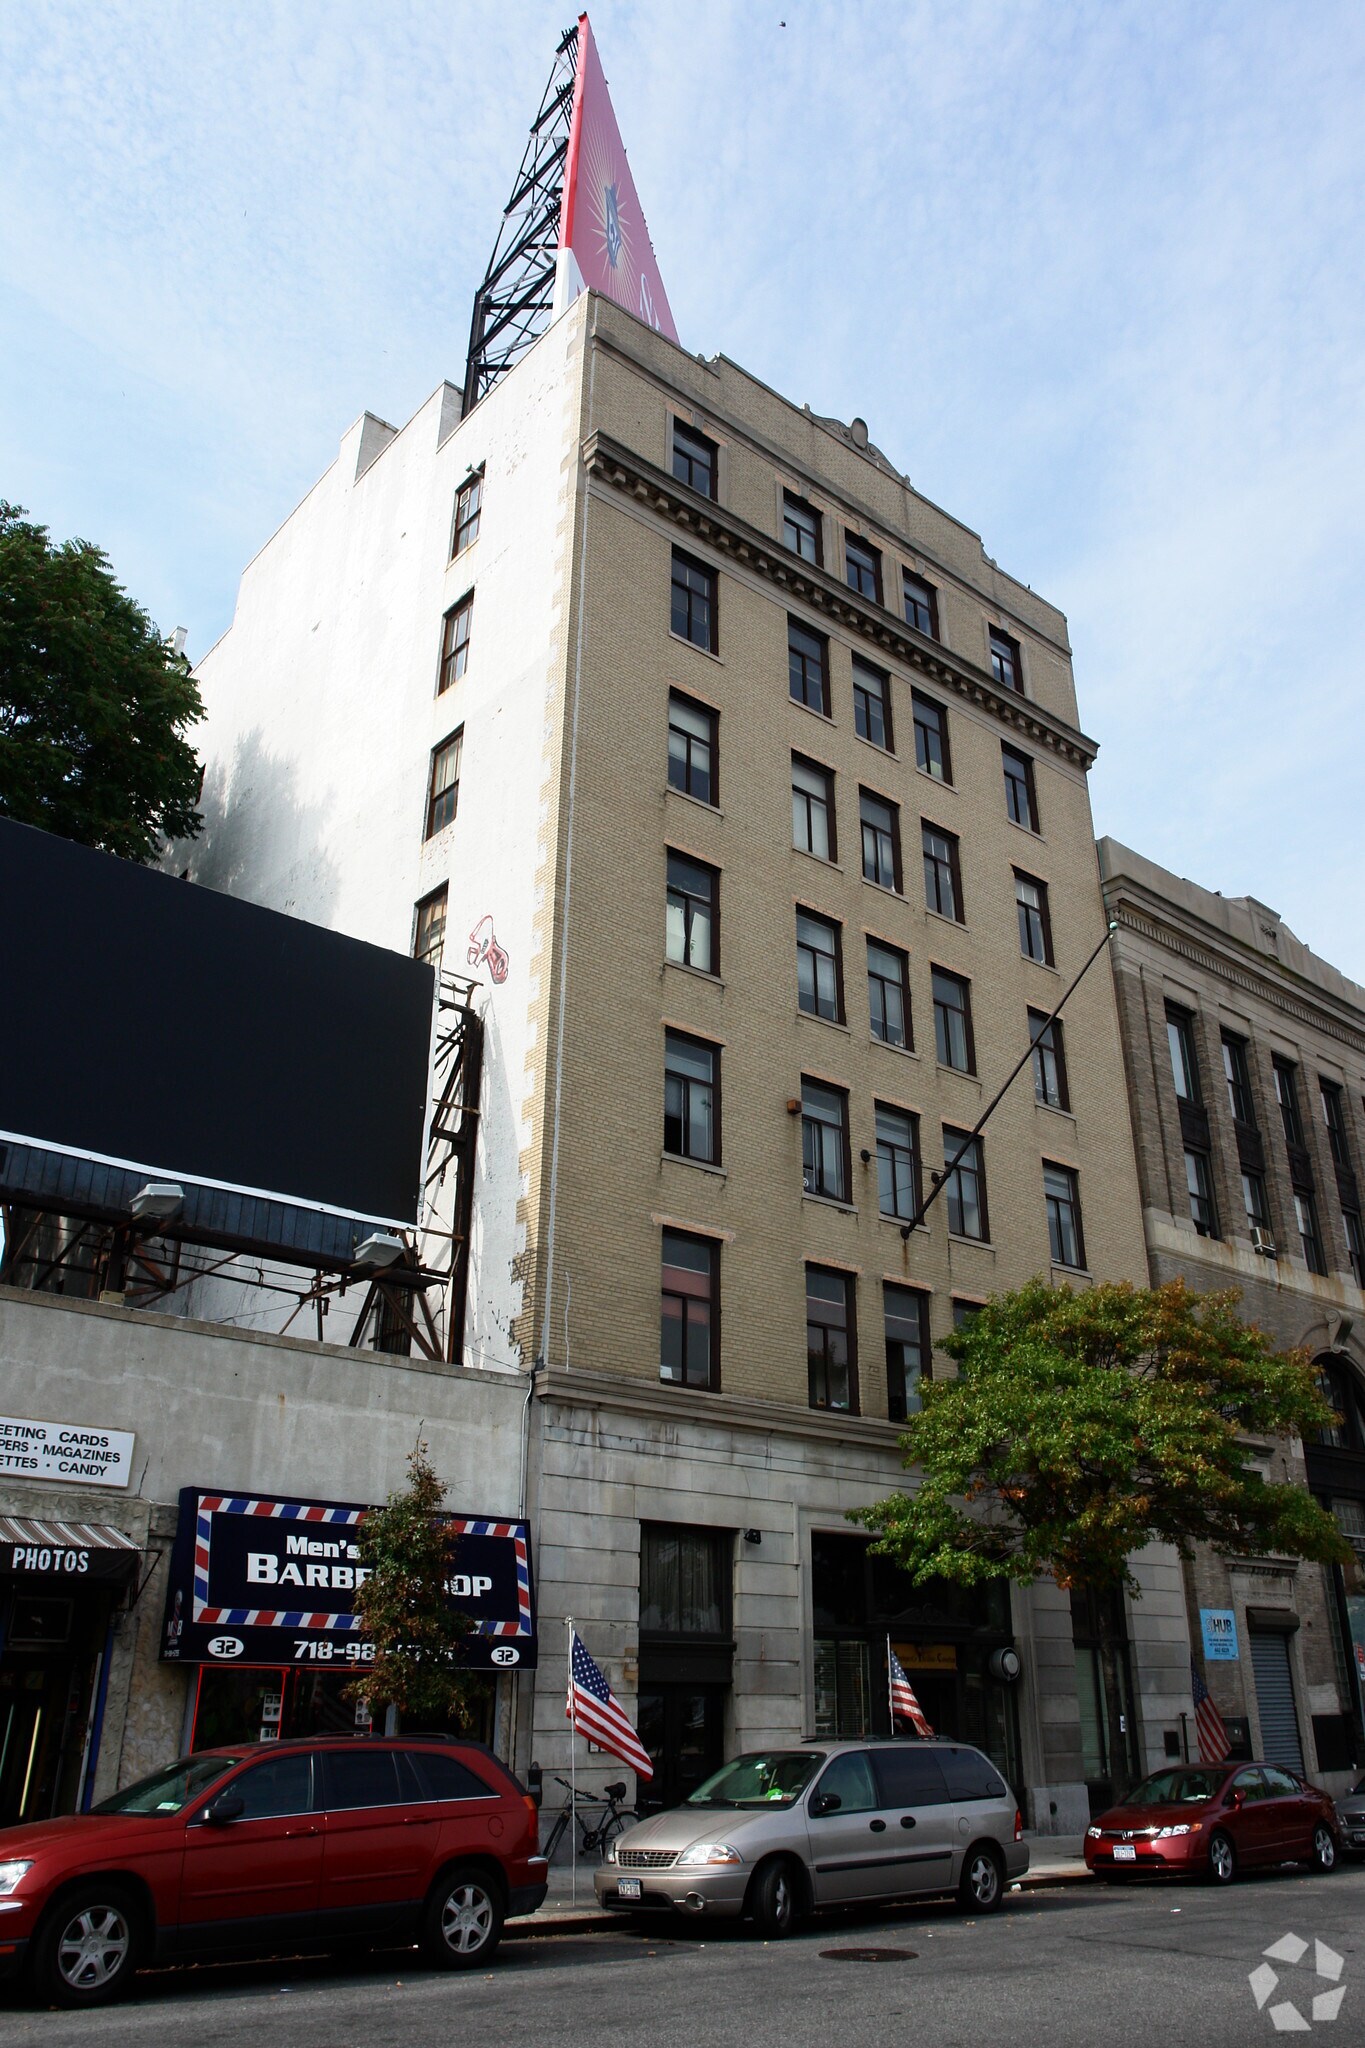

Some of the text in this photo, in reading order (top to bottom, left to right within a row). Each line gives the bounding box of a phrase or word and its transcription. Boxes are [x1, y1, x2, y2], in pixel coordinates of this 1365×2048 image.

[59, 1431, 109, 1447] CARDS
[42, 1444, 121, 1463] MAGAZINES
[58, 1461, 108, 1476] CANDY
[11, 1546, 89, 1573] PHOTOS
[215, 1640, 236, 1654] 32
[497, 1649, 513, 1662] 32
